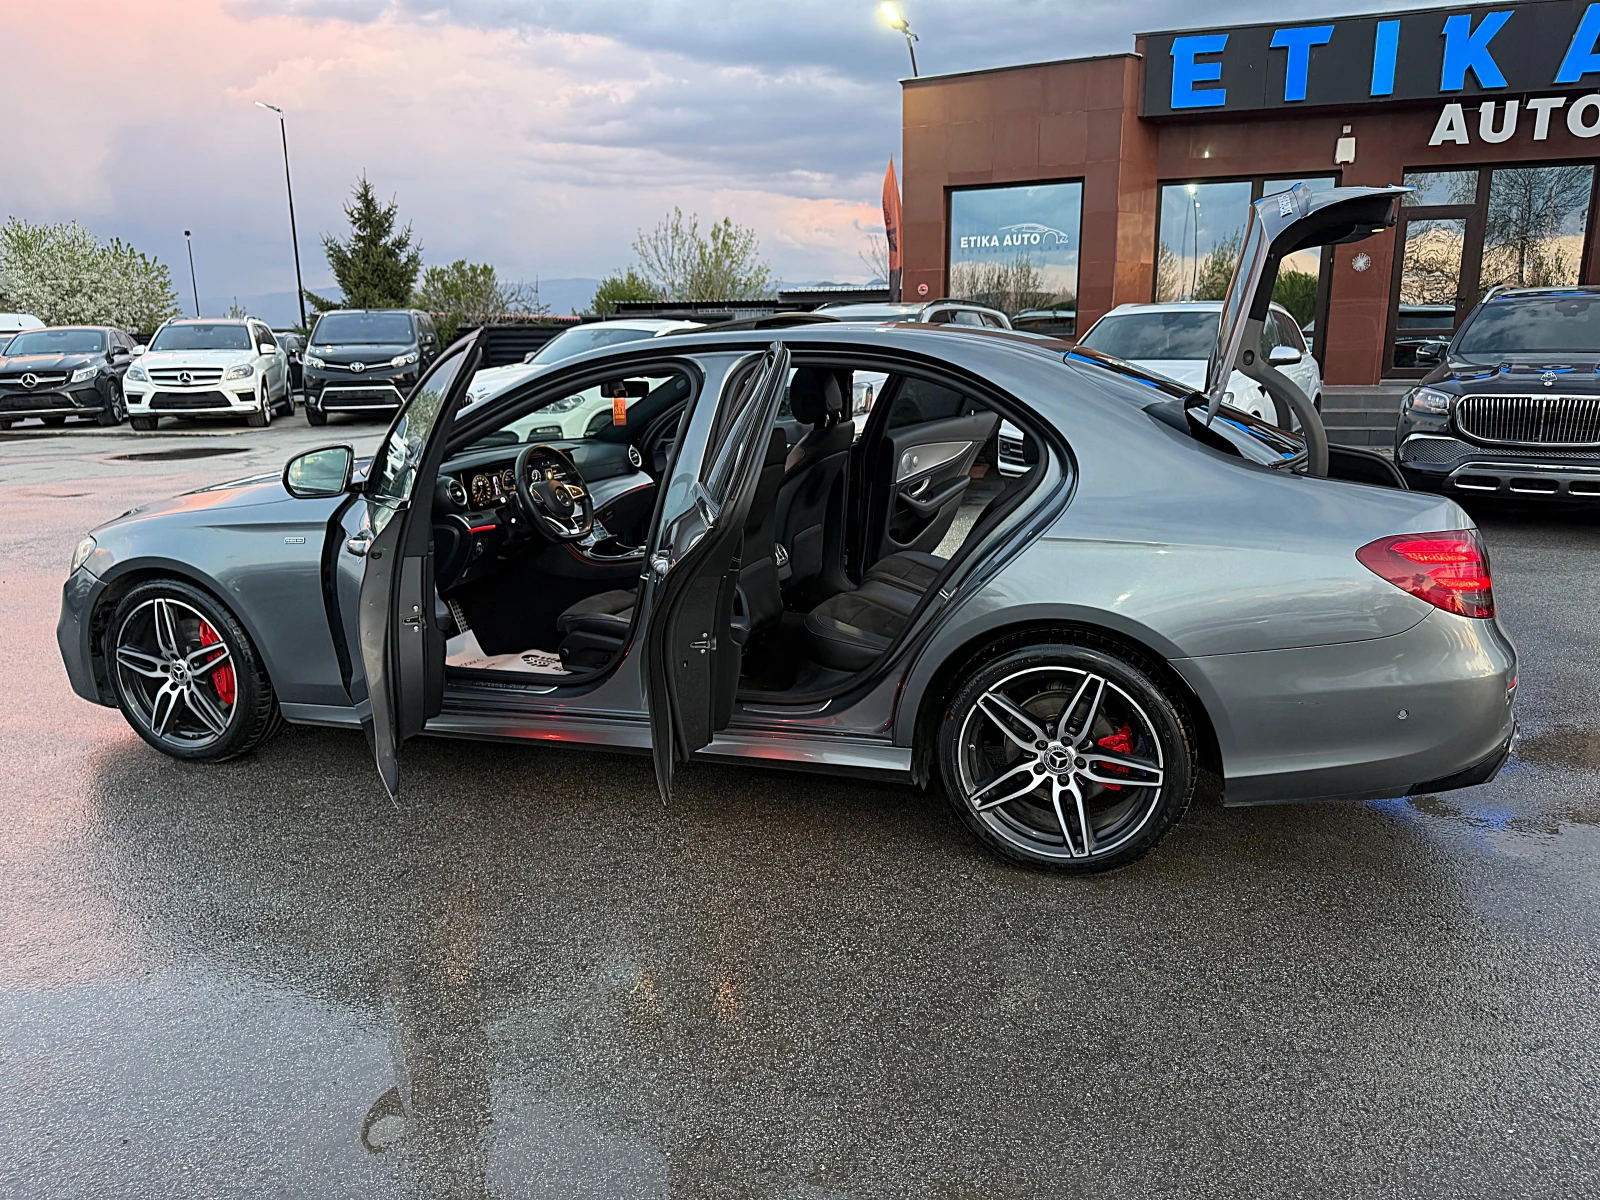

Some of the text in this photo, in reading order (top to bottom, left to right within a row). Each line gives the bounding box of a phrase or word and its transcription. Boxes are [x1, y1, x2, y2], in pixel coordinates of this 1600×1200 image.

[1170, 3, 1600, 109] ETIKA
[1428, 94, 1600, 146] AUTO
[960, 233, 1041, 248] ETIKA AUTO
